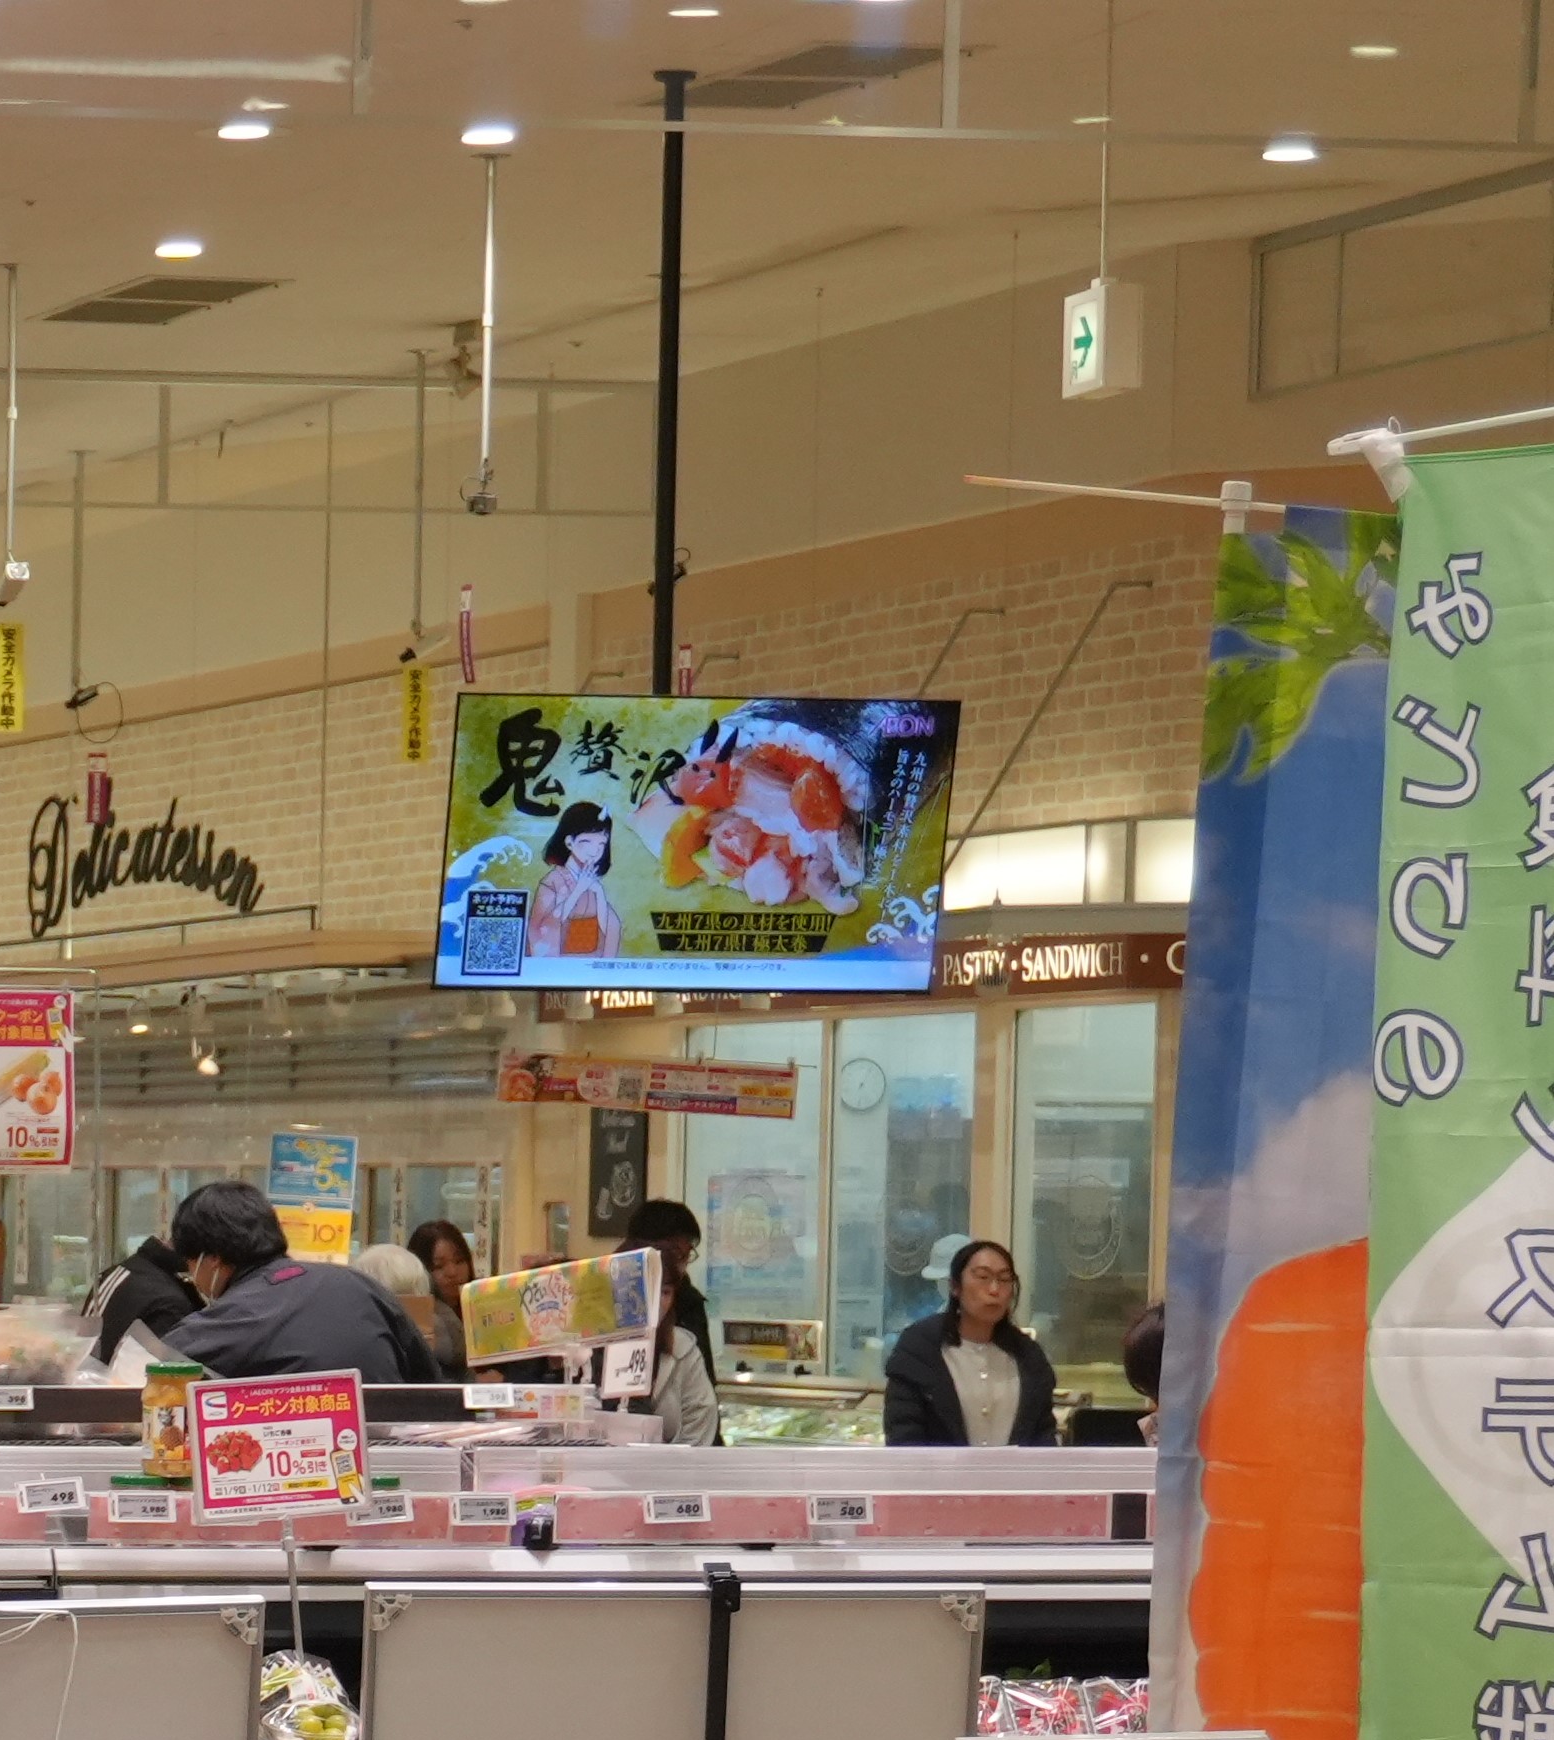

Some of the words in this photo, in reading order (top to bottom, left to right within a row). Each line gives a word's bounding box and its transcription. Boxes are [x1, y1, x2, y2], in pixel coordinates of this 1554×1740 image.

[1020, 941, 1125, 982] SANDWICH
[231, 1393, 352, 1419] クーポン対象商品
